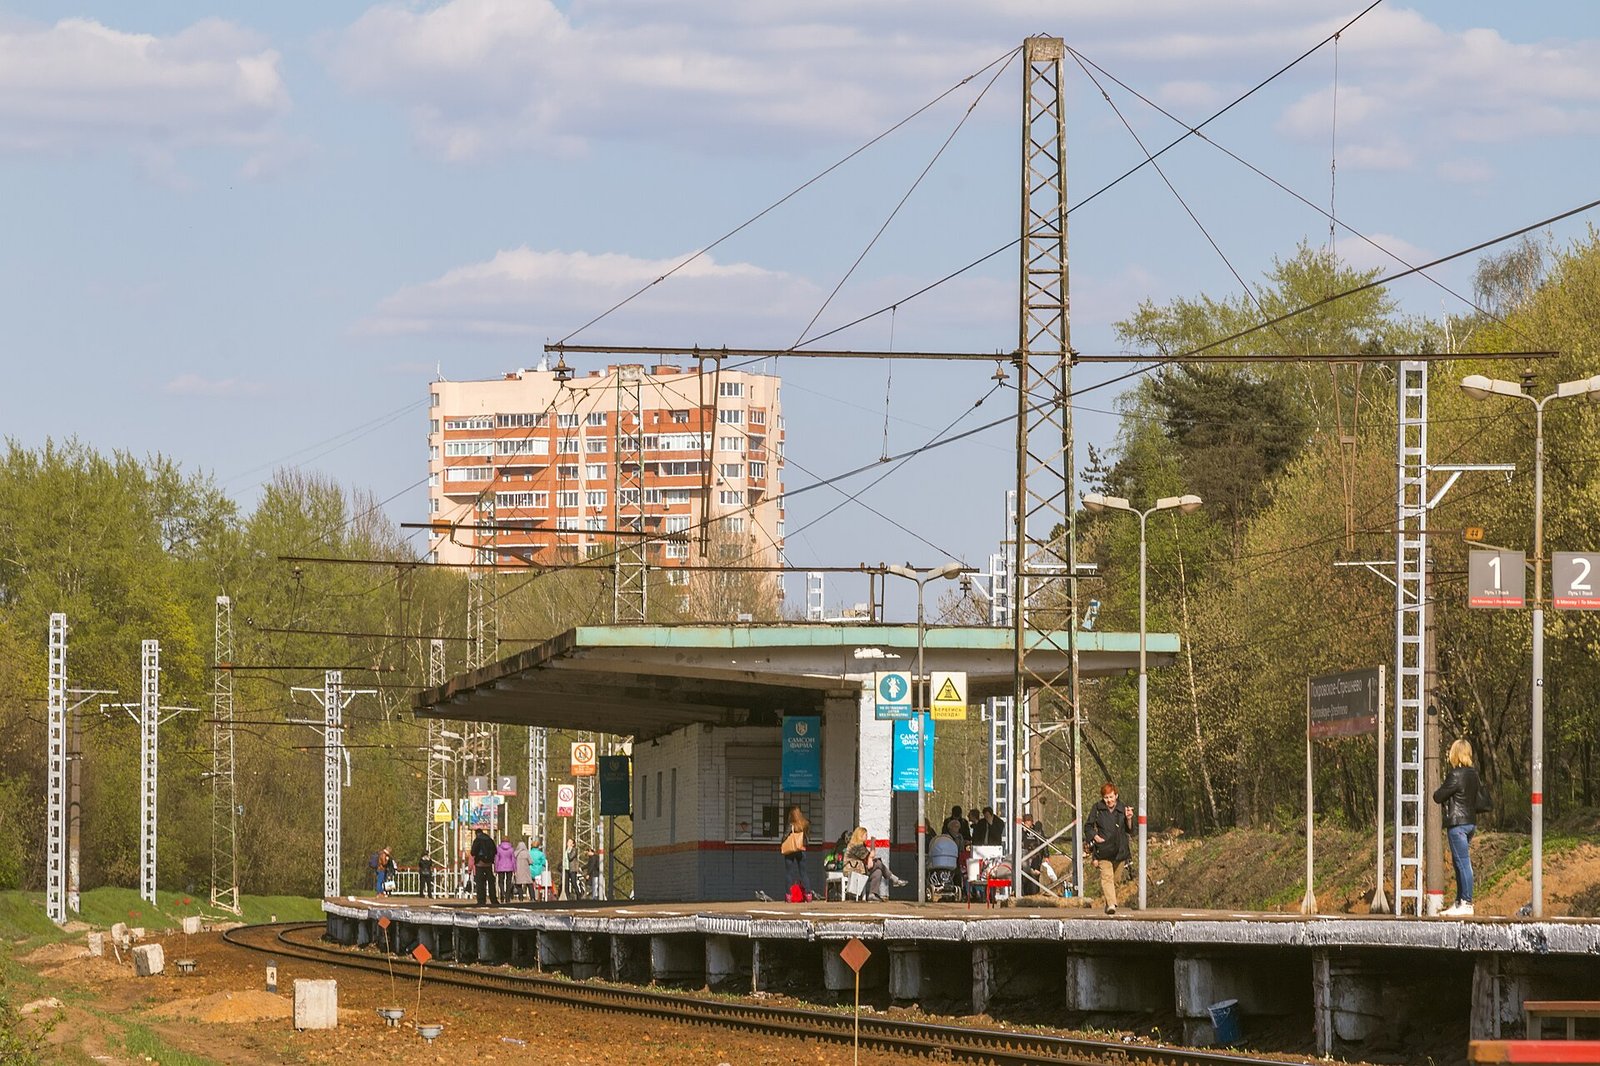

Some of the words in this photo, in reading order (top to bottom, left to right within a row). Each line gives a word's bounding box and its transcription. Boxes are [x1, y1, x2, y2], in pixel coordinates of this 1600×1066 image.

[1488, 557, 1501, 589] 1
[1571, 558, 1591, 590] 2
[474, 777, 480, 790] 1
[503, 777, 511, 790] 2
